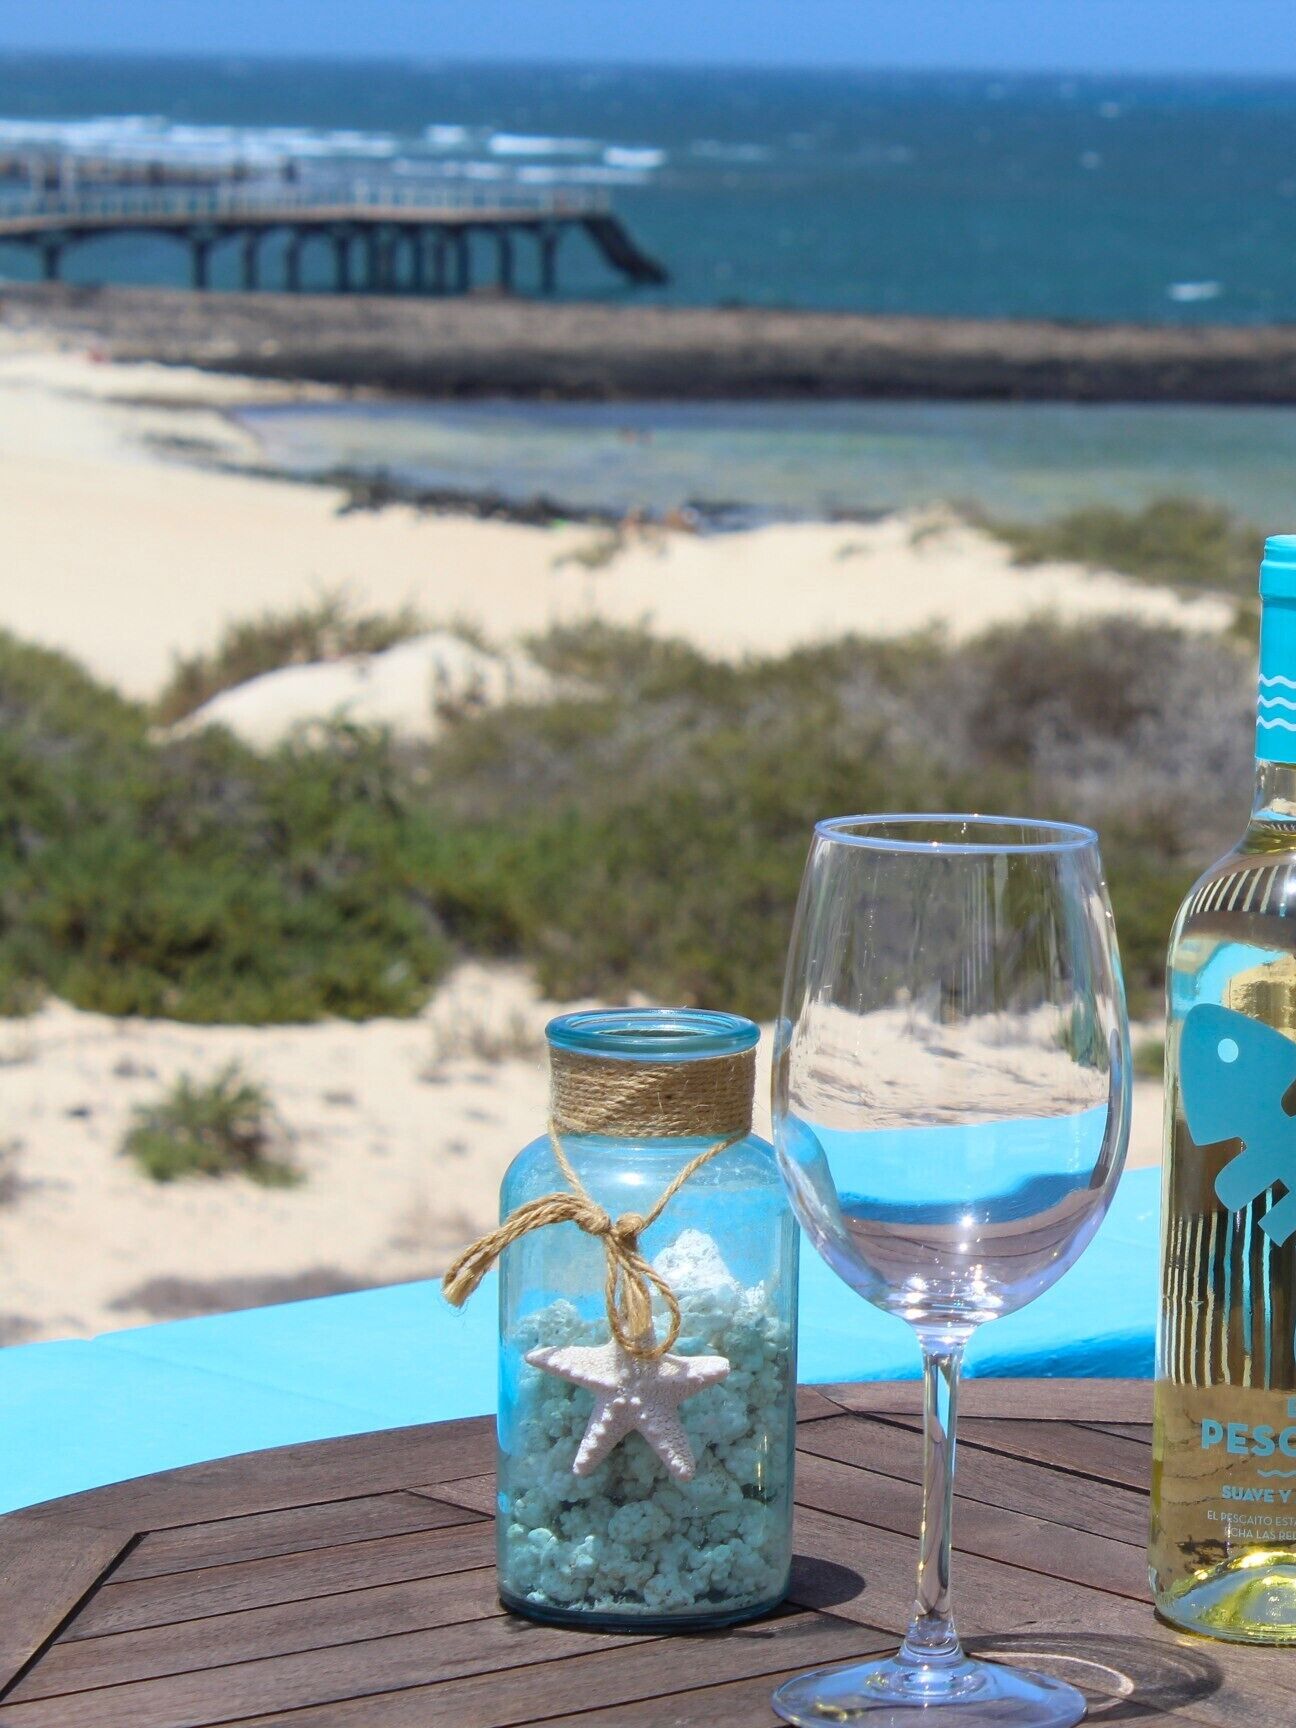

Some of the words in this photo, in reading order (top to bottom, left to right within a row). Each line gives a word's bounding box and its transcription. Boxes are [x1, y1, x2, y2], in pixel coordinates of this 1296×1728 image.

[1222, 1485, 1275, 1503] SUAVE
[1279, 1490, 1292, 1504] Y
[1207, 1510, 1219, 1521] EL
[1256, 1529, 1276, 1540] LAS
